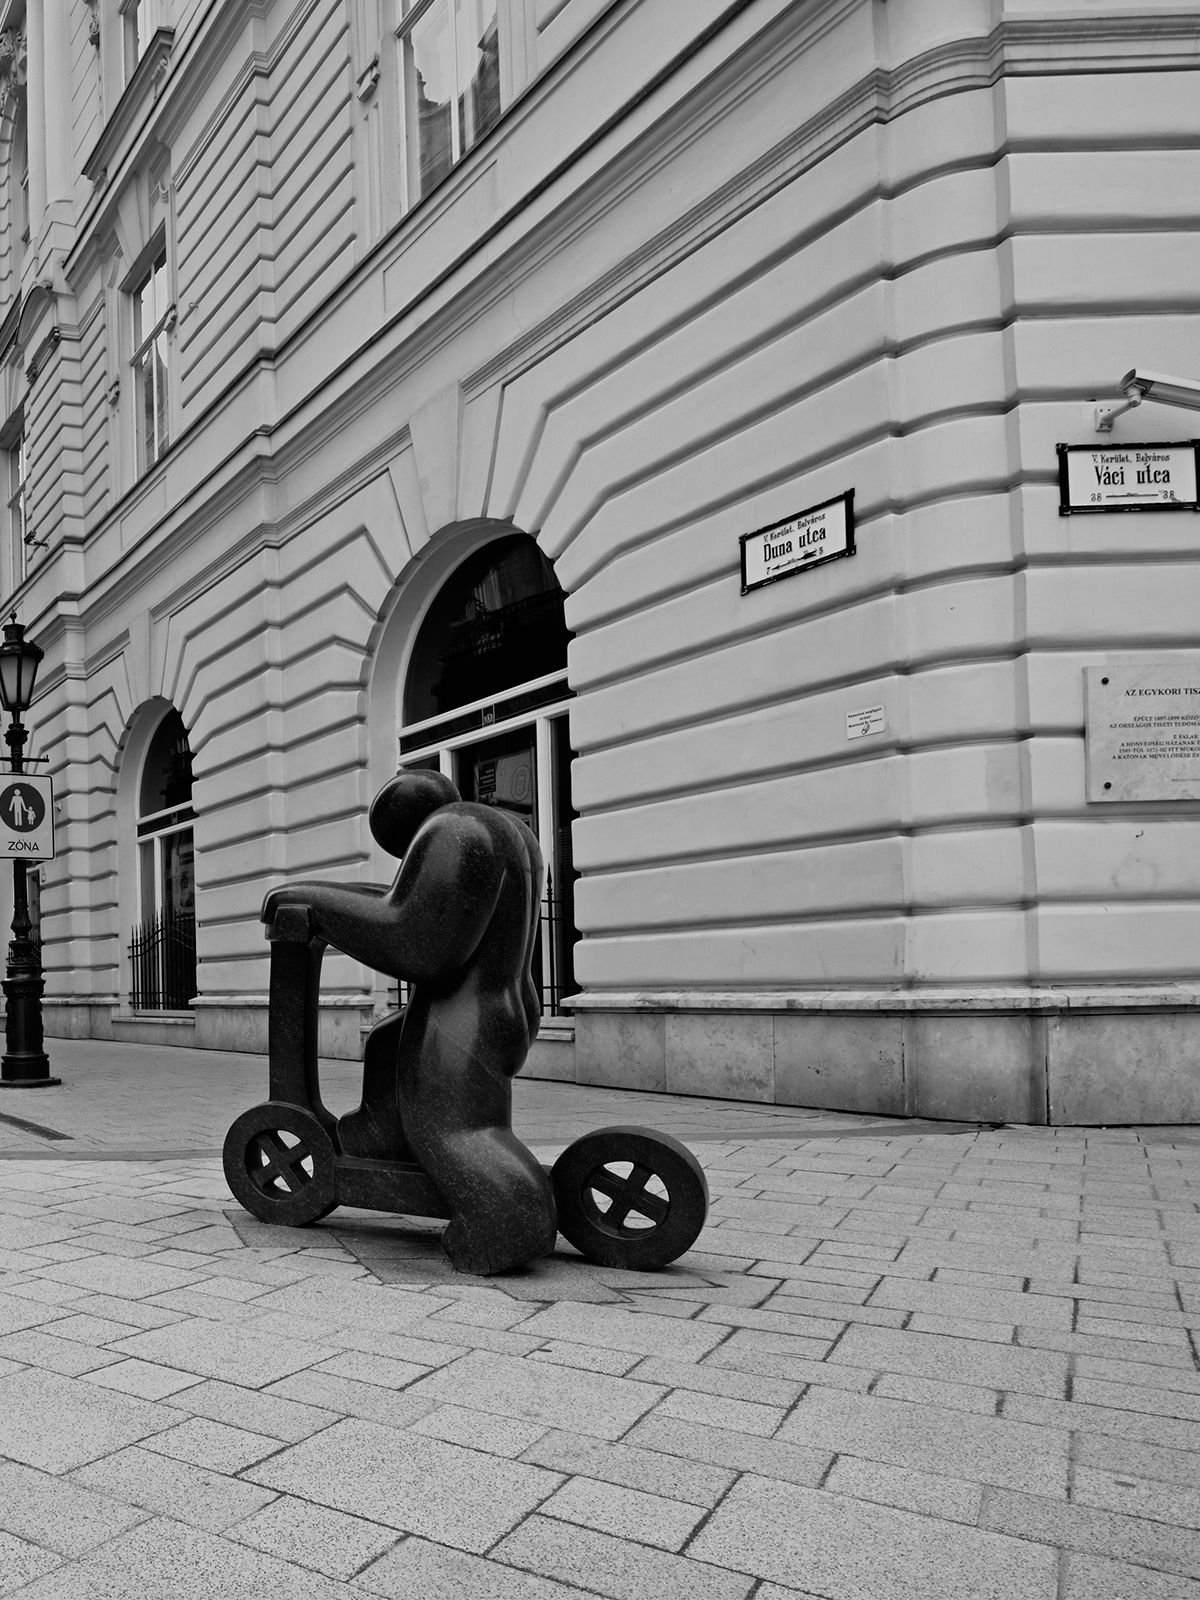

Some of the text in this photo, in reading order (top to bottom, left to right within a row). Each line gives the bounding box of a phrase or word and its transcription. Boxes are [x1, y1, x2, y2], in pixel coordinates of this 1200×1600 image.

[1135, 452, 1171, 463] Belváros
[1094, 464, 1171, 485] Váci utca
[763, 527, 826, 562] Duna utca
[1124, 689, 1137, 697] AZ
[1138, 688, 1181, 696] EGYKORI
[7, 838, 40, 852] ZÓNA
